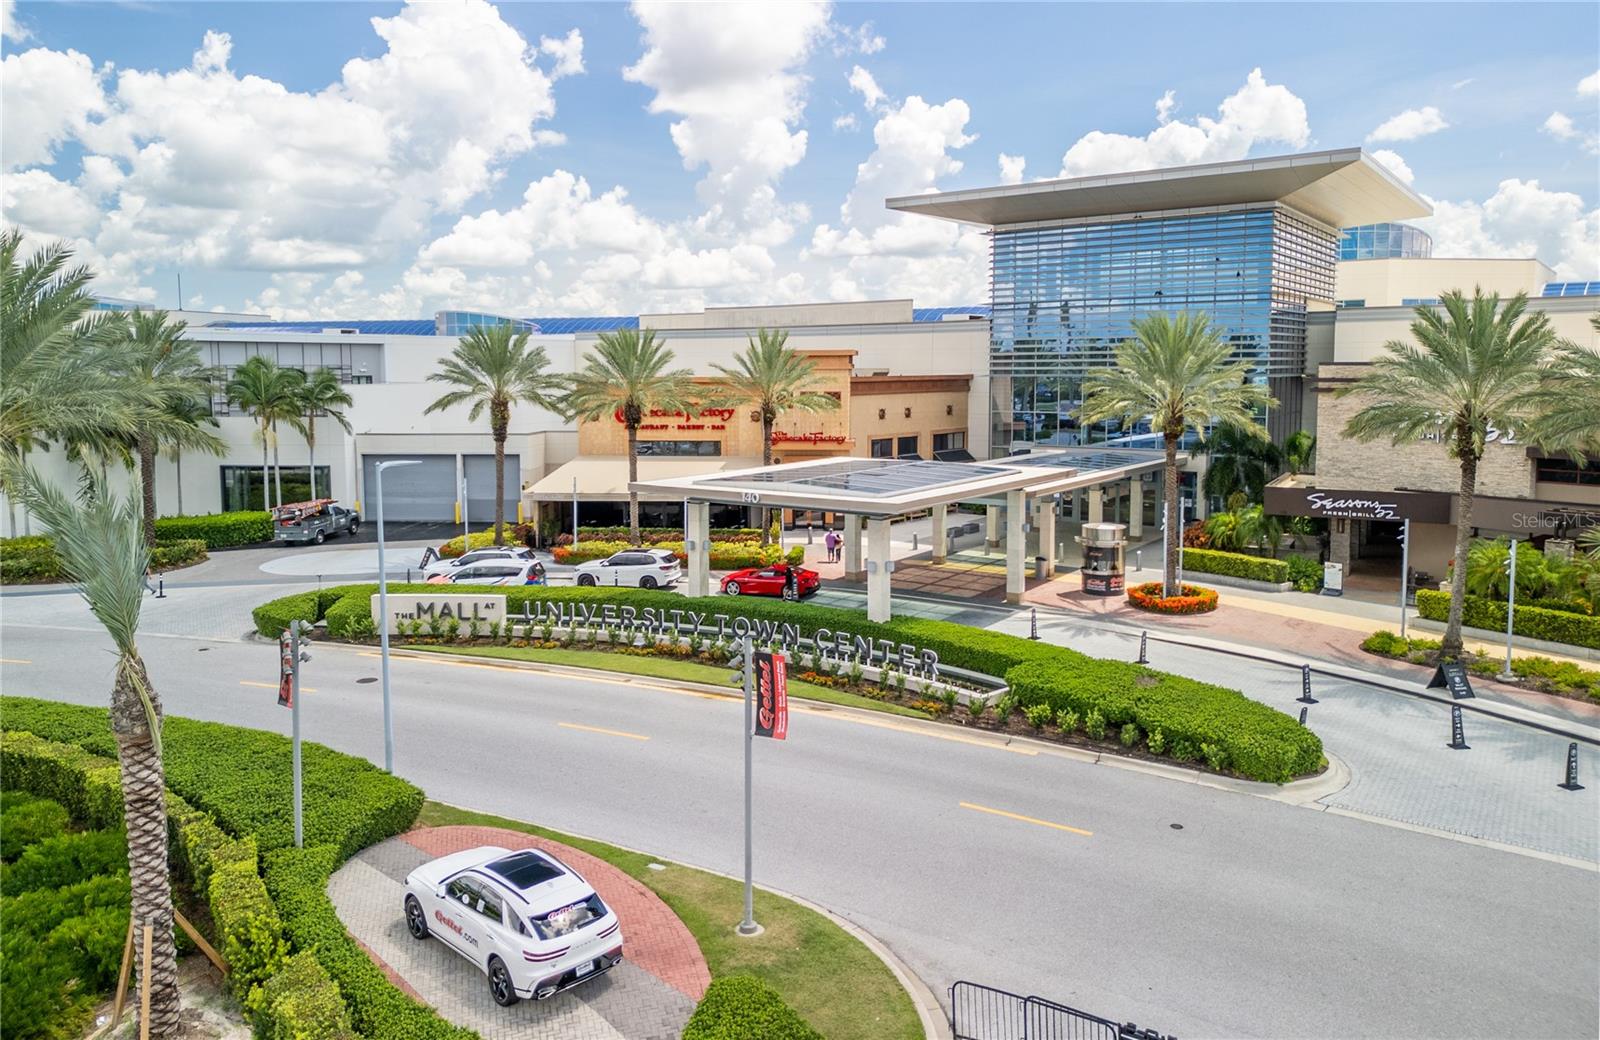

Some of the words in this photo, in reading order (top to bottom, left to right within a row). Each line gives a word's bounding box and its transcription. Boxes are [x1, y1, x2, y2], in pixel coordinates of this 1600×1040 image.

[809, 431, 847, 446] Factory
[742, 492, 760, 504] 140
[1306, 492, 1380, 510] Seasons
[1374, 504, 1401, 520] 52
[394, 612, 414, 620] THE
[415, 601, 488, 621] MALL
[523, 600, 707, 633] UNIVERSITY
[714, 614, 800, 646] TOWN
[813, 628, 939, 675] CENTER
[759, 659, 775, 730] Gettel
